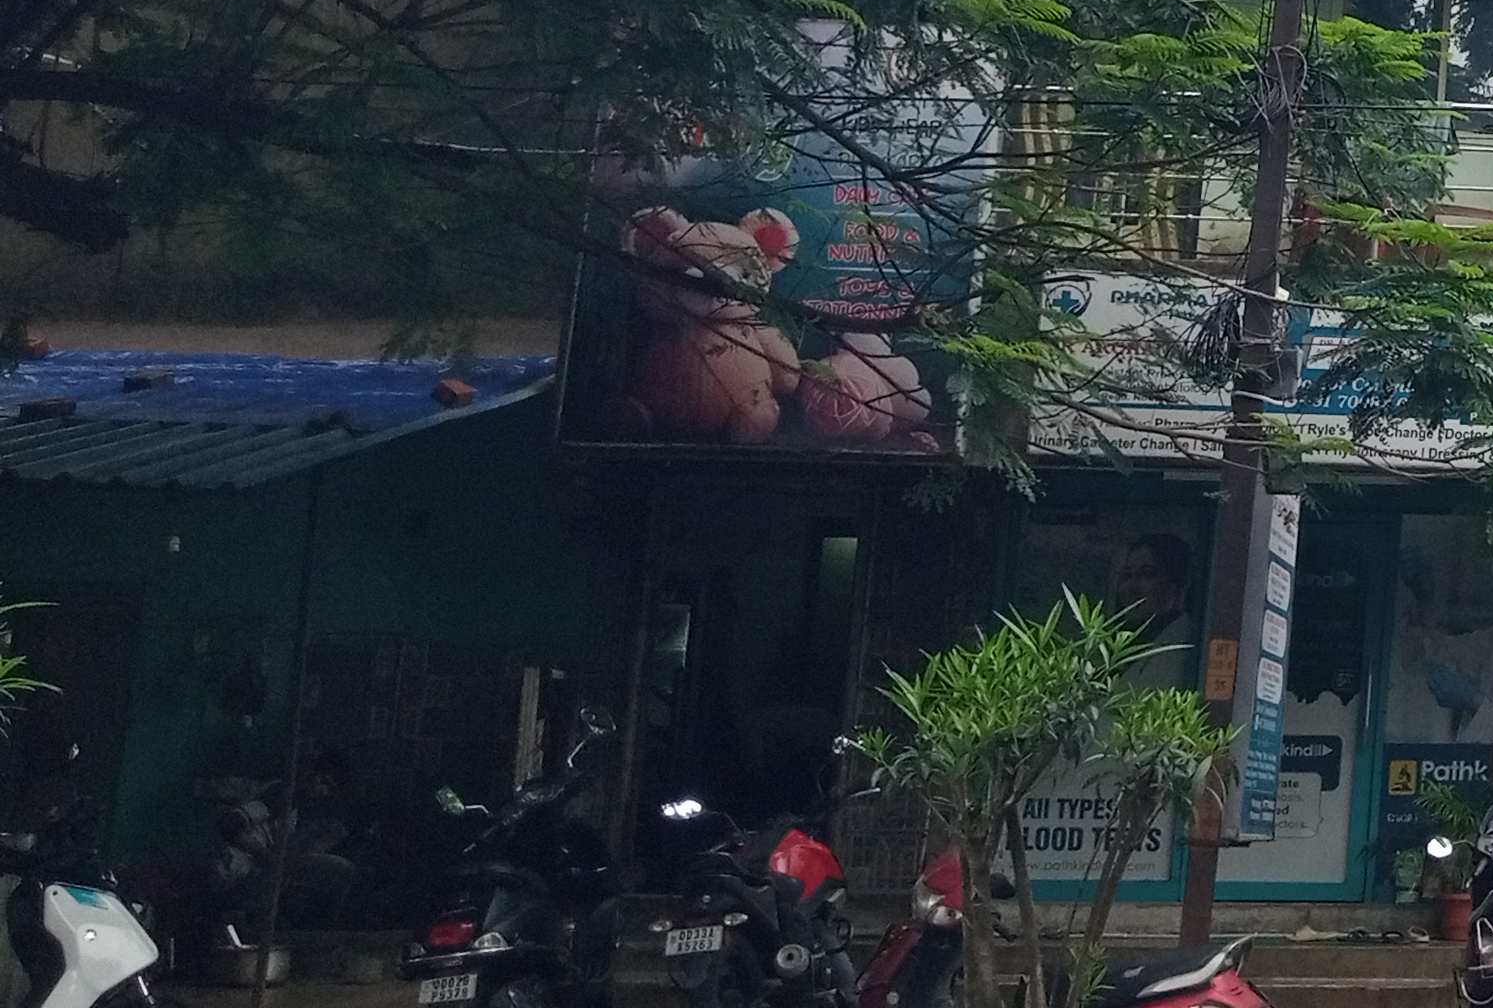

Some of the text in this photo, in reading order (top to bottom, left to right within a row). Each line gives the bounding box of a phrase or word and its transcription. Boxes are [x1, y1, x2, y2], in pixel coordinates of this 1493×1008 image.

[1308, 424, 1346, 438] Ryle's
[1080, 435, 1136, 450] Caeter
[1140, 436, 1189, 453] Change
